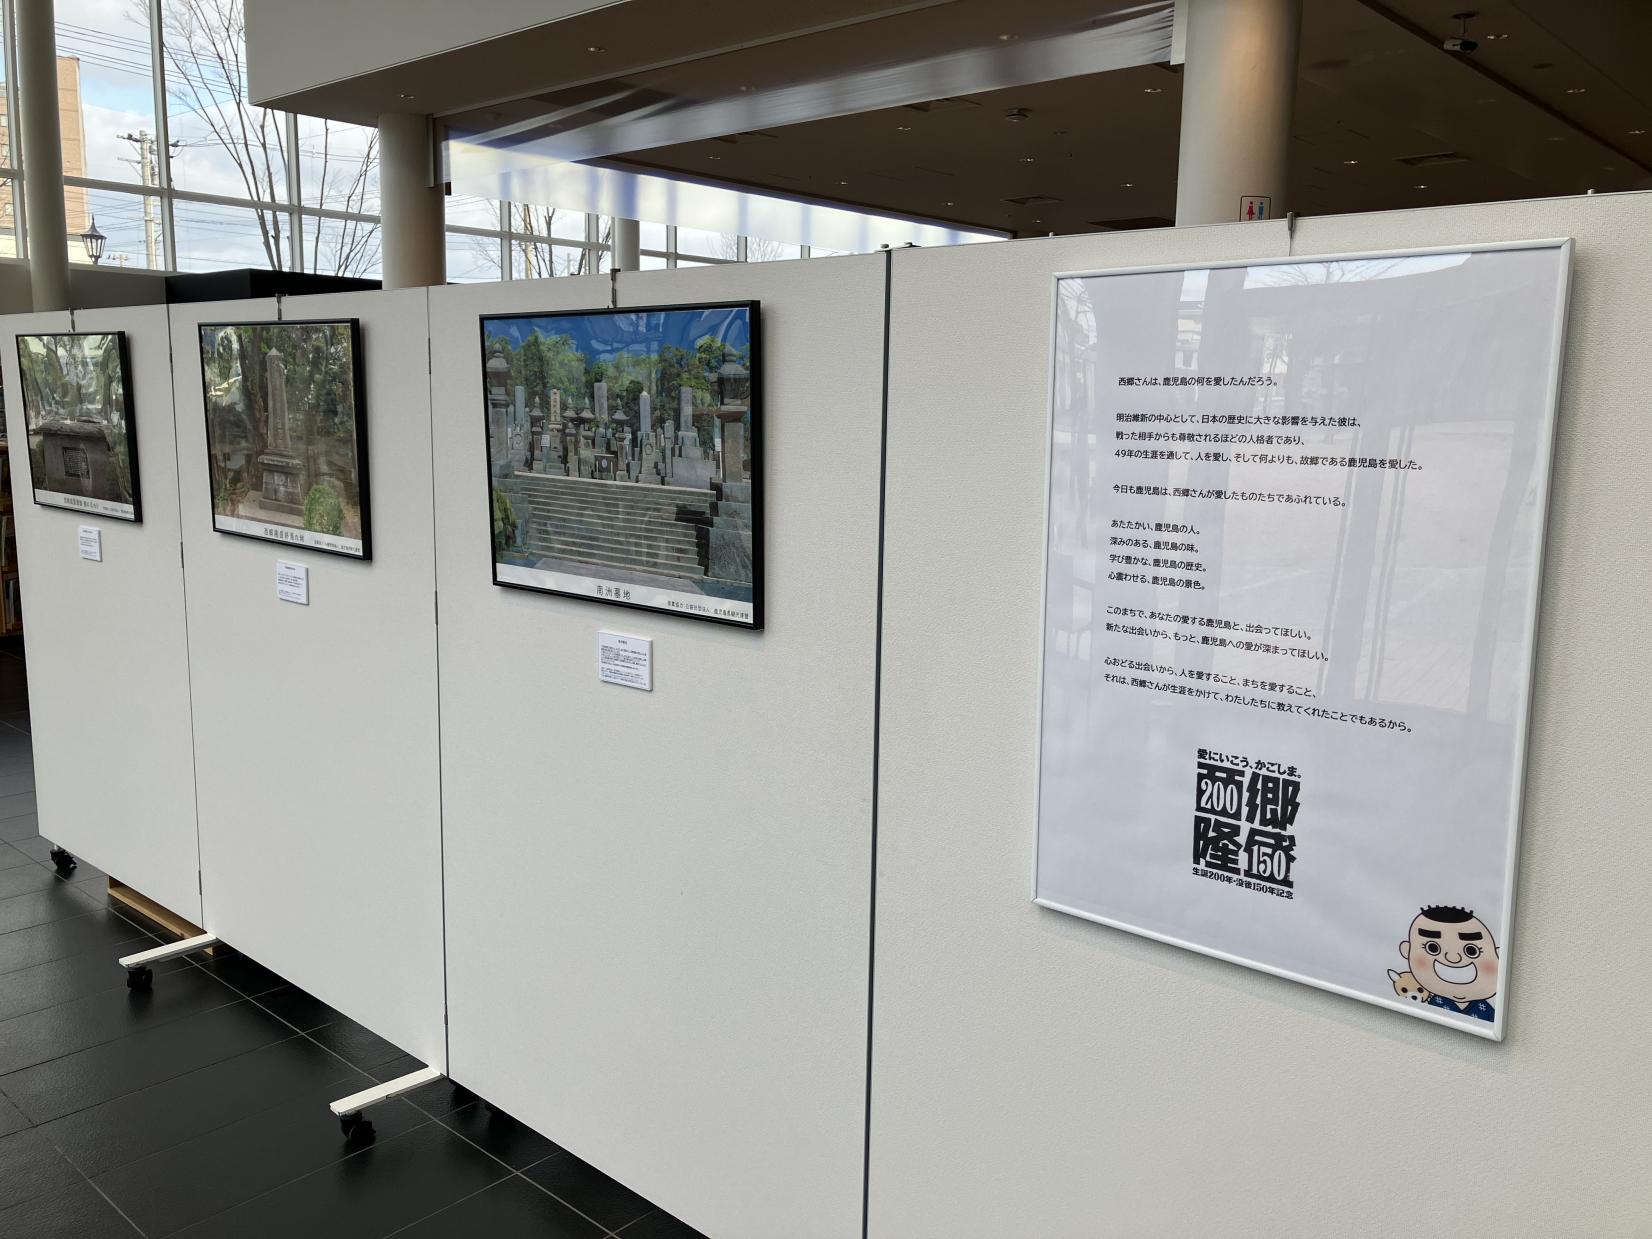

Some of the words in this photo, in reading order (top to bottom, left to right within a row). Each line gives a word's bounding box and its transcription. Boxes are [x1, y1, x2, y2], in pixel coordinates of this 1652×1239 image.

[1118, 376, 1278, 387] 西郷さんは、鹿児島の何を愛したんだろう。
[1116, 413, 1362, 428] 明治維新の中心として、日本の歴史に大きな影響を与えた彼は、
[1115, 431, 1305, 446] 戦った相手からも尊敬されるほどの人格者であり、
[1114, 449, 1423, 471] 49年の生涯を通して、人を愛し、そして何よりも、故郷である鹿児島を愛した。
[1112, 483, 1347, 507] 今日も鹿児島は、西郷さんが愛したものたちであふれている。
[1110, 519, 1201, 535] あたたかい、鹿児島の人。
[1109, 536, 1199, 553] 深みのある、鹿児島の味。
[1108, 554, 1207, 572] 学び豊かな、鹿児島の歴史。
[1107, 571, 1205, 590] 心震わせる、鹿児島の景色。
[596, 585, 632, 601] 南洲墓地
[1106, 605, 1312, 641] このまちで、あなたの愛する鹿児島と、出会ってほしい。
[1105, 622, 1329, 662] 新たな出会いから、もっと、鹿児島への愛が深まってほしい。
[1103, 656, 1316, 698] 心おどる出会いから、人を愛すること、まちを愛すること、
[1103, 673, 1412, 733] それは、西郷さんが生涯をかけて、わたしたちに教えてくれたことでもあるから。
[1196, 748, 1302, 779] 愛にいこう、かごしま。
[1200, 779, 1239, 815] 200
[1251, 844, 1288, 881] 150
